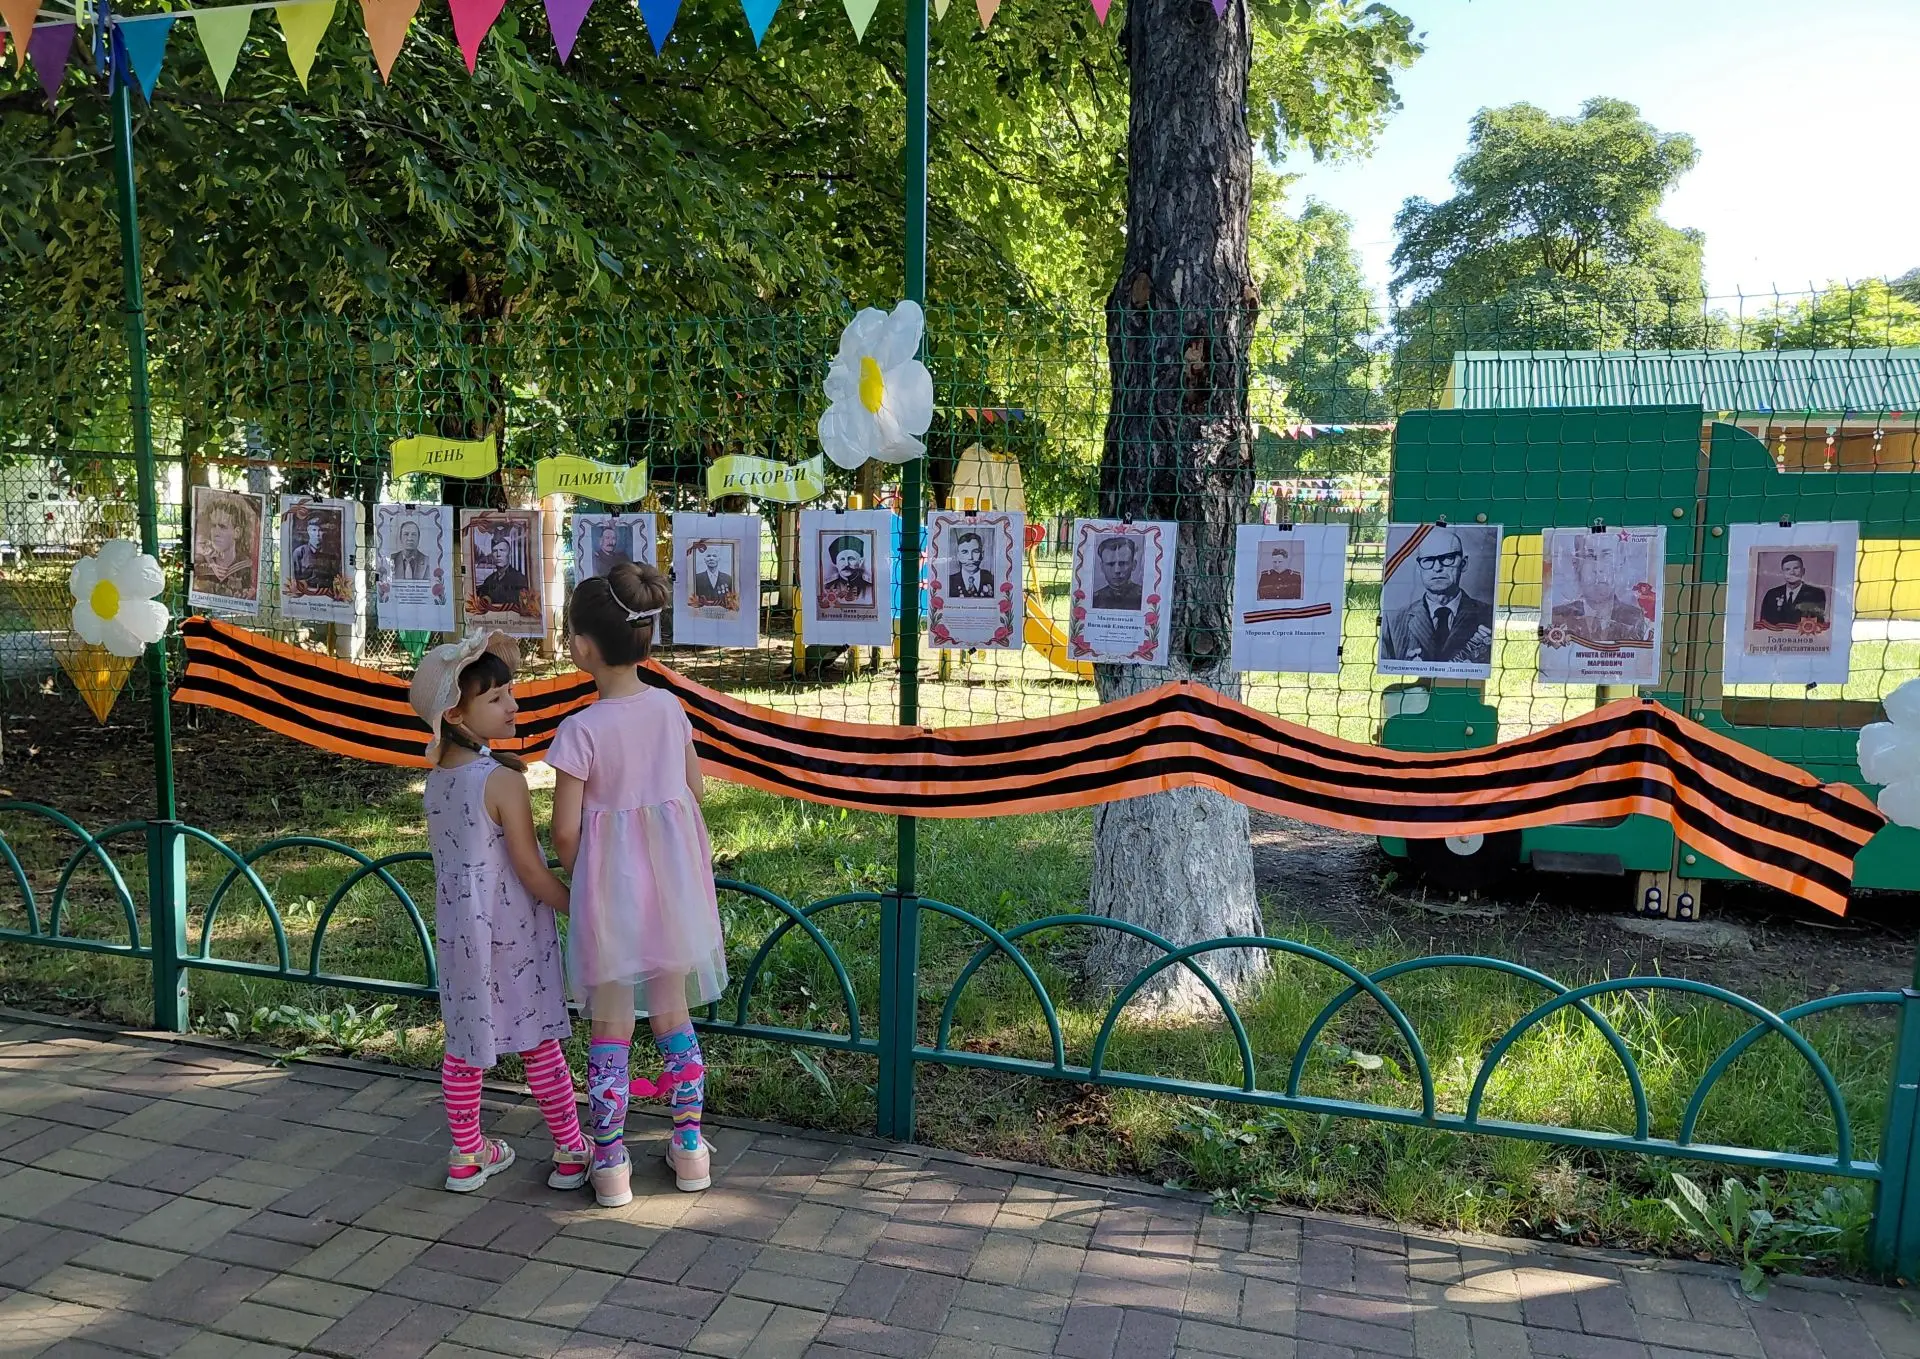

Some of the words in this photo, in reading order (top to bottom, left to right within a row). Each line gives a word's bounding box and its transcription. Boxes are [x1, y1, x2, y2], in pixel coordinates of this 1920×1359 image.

[421, 448, 464, 466] ДЕНЬ
[557, 471, 626, 487] ПАМЯТИ
[723, 474, 735, 488] И
[740, 467, 806, 487] СКОРБИ
[1767, 635, 1814, 643] Голованов
[1749, 644, 1777, 653] Григорий
[1778, 644, 1830, 652] Константинович
[1576, 651, 1599, 659] МУШТА
